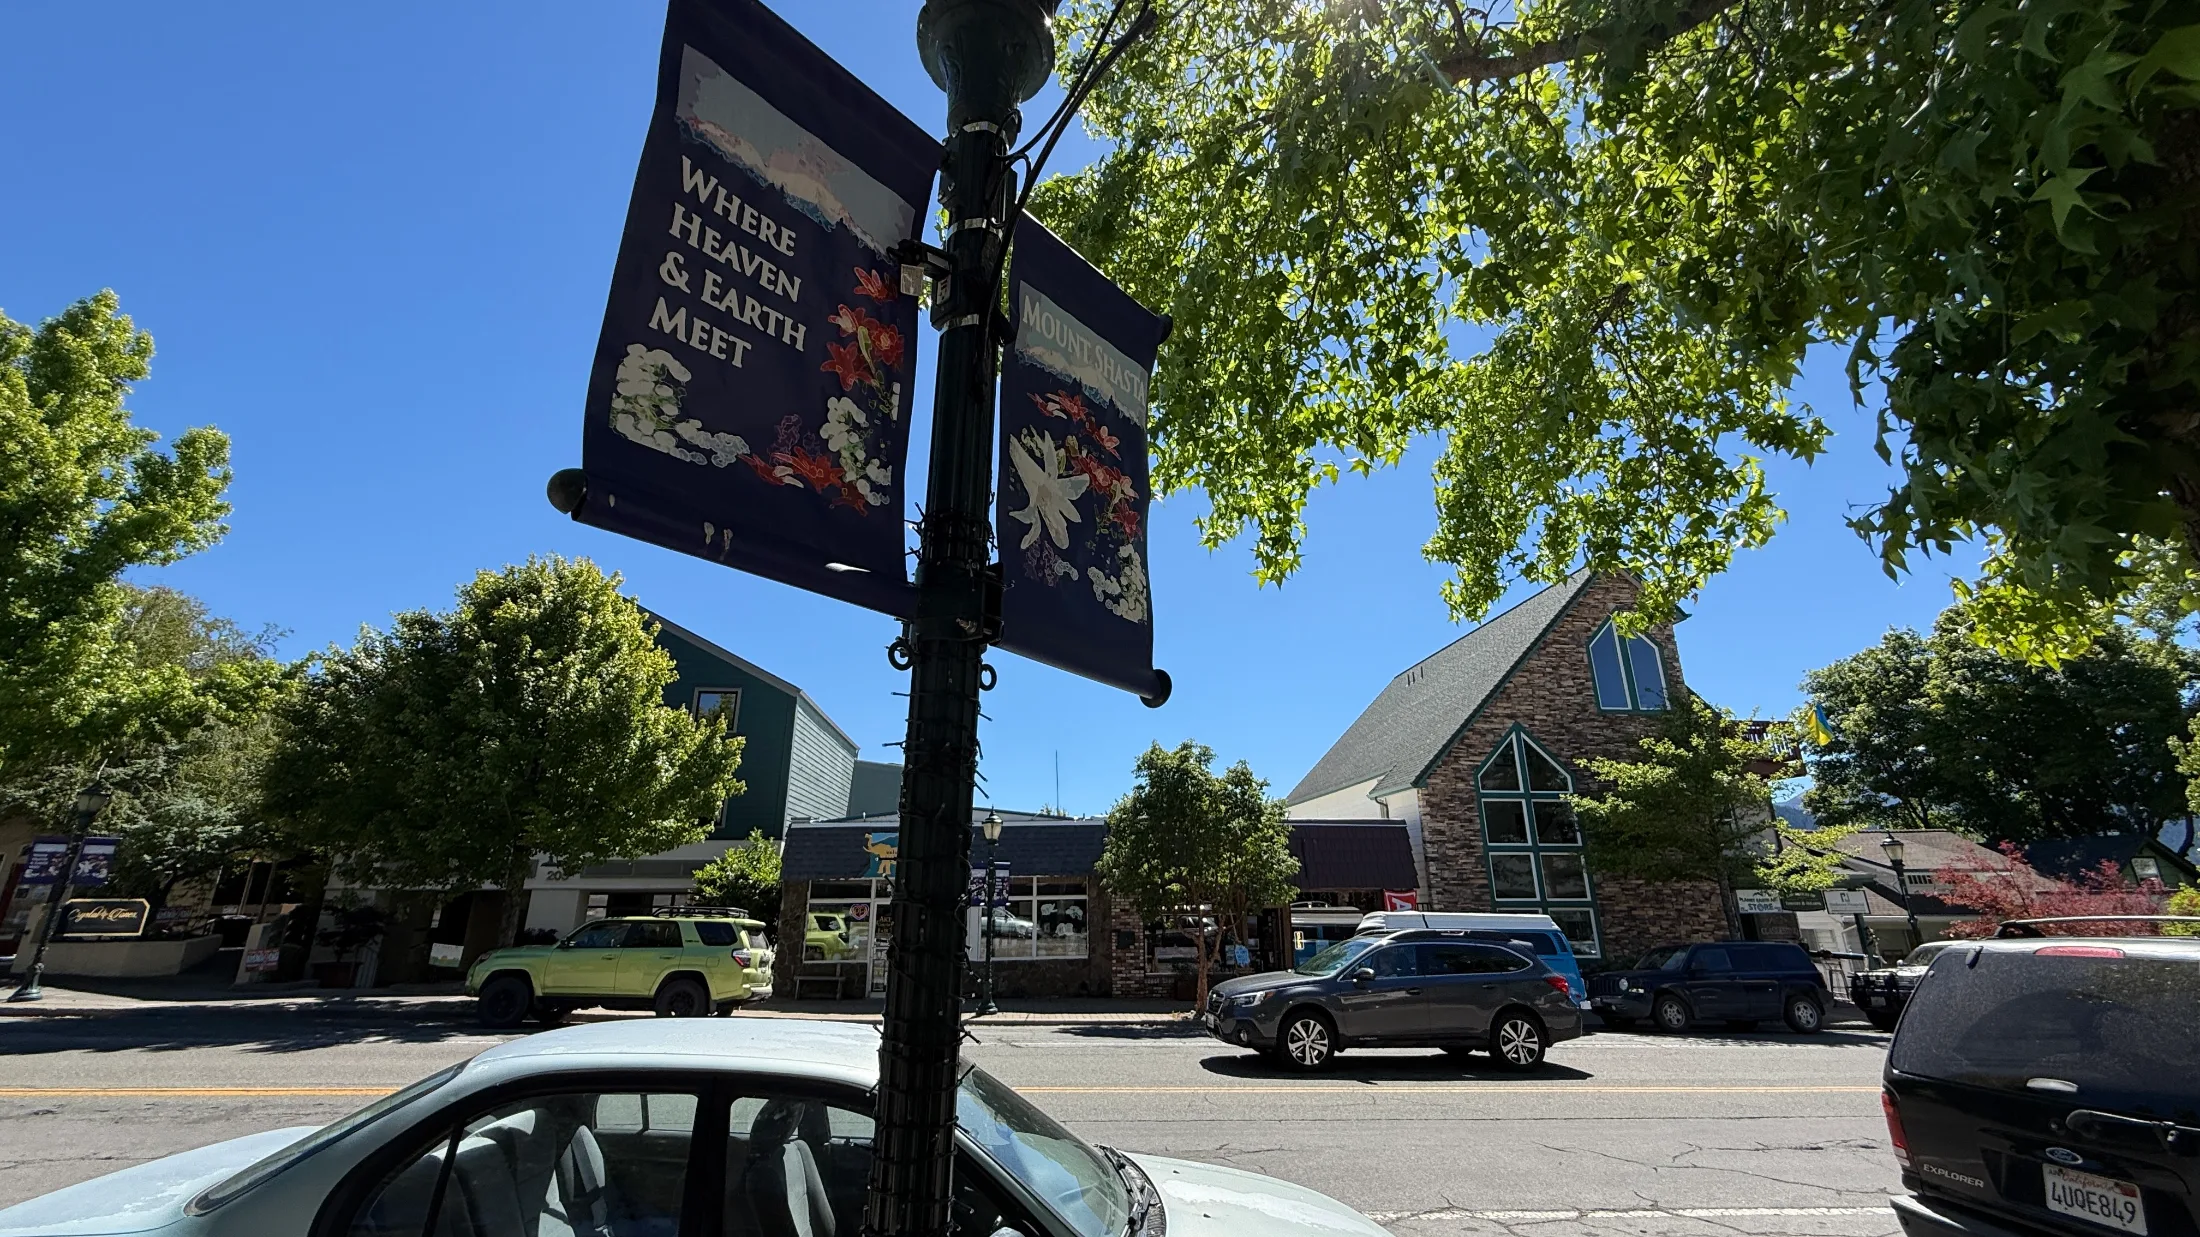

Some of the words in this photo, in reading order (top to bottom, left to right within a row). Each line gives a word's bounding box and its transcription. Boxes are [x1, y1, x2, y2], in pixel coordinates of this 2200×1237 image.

[682, 154, 797, 257] WHERE
[668, 202, 802, 303] HEAVEN
[648, 296, 752, 368] MEET
[659, 251, 691, 294] &
[701, 268, 807, 352] EARTH
[1022, 294, 1092, 365] MOUNT
[1094, 345, 1147, 408] SHASTA
[1748, 903, 1774, 912] STORE
[1923, 1163, 1984, 1189] EXPLORER
[2051, 1181, 2136, 1224] 4UQE849
